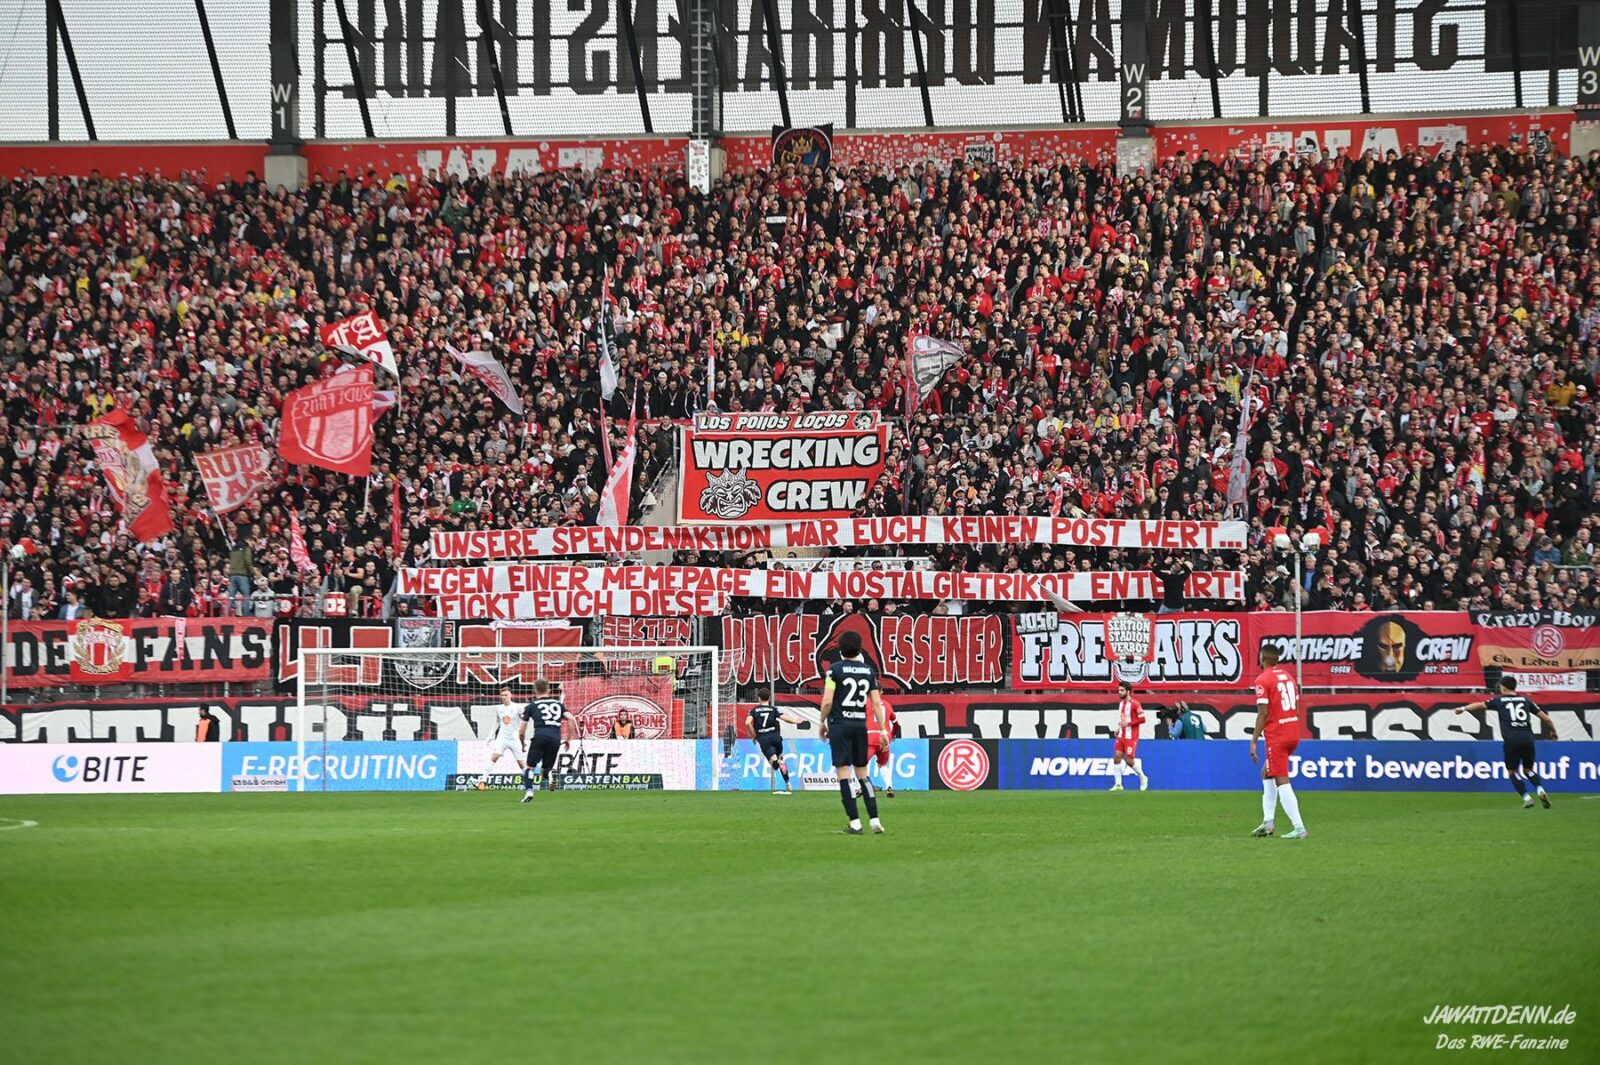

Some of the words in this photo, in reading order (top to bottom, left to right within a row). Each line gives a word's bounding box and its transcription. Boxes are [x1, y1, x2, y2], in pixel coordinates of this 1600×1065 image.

[1578, 48, 1599, 66] W
[1123, 63, 1144, 82] W
[1581, 72, 1597, 94] 3
[271, 83, 291, 103] W
[1126, 89, 1142, 112] 2
[276, 106, 286, 129] 1
[700, 414, 731, 430] LOS
[793, 413, 849, 430] LOCOS
[693, 435, 879, 469] WRECKING
[766, 480, 868, 511] CREW
[433, 529, 539, 559] UNSERE
[552, 525, 771, 554] SPENDENAKTION
[787, 519, 838, 547] WAR
[853, 516, 927, 544] EUCH
[944, 516, 1038, 544] KEINEN
[1052, 518, 1126, 545] POST
[1141, 520, 1242, 549] WERT...
[401, 566, 494, 594] WEGEN
[509, 566, 588, 592] EINER
[603, 566, 752, 597] MEMEPAGE
[767, 571, 812, 598] EIN
[828, 571, 1075, 600] NOSTALGIETRIKOT
[1092, 571, 1242, 599] ENTERT!
[441, 592, 519, 619] FICKT
[533, 590, 613, 617] EUCH
[631, 590, 726, 617] DIESE!
[602, 616, 691, 639] SEKTION
[1107, 619, 1150, 632] SEKTION
[1108, 632, 1150, 643] STADION
[1111, 642, 1149, 653] VERBOT
[11, 631, 69, 676] DE
[133, 624, 267, 672] FANS
[715, 614, 819, 686] JUNGE
[880, 615, 1003, 685] ESSENER
[1261, 637, 1364, 662] ORTHSIDE
[1415, 637, 1471, 662] CREW
[1521, 656, 1560, 668] Leben
[1527, 673, 1563, 686] BANDA
[842, 677, 870, 707] 23
[1277, 681, 1296, 711] 30
[537, 703, 561, 721] 39
[761, 712, 770, 728] 7
[1505, 702, 1527, 721] 16
[83, 756, 148, 782] BITE
[241, 754, 438, 780] E-RECRUITING
[719, 753, 917, 779] E-RECRUNG
[1030, 758, 1143, 776] NOWEA
[1288, 756, 1357, 779] Jetzt
[1366, 755, 1509, 779] bewerben
[1534, 755, 1570, 779] uf
[563, 775, 651, 785] GARTENBAU
